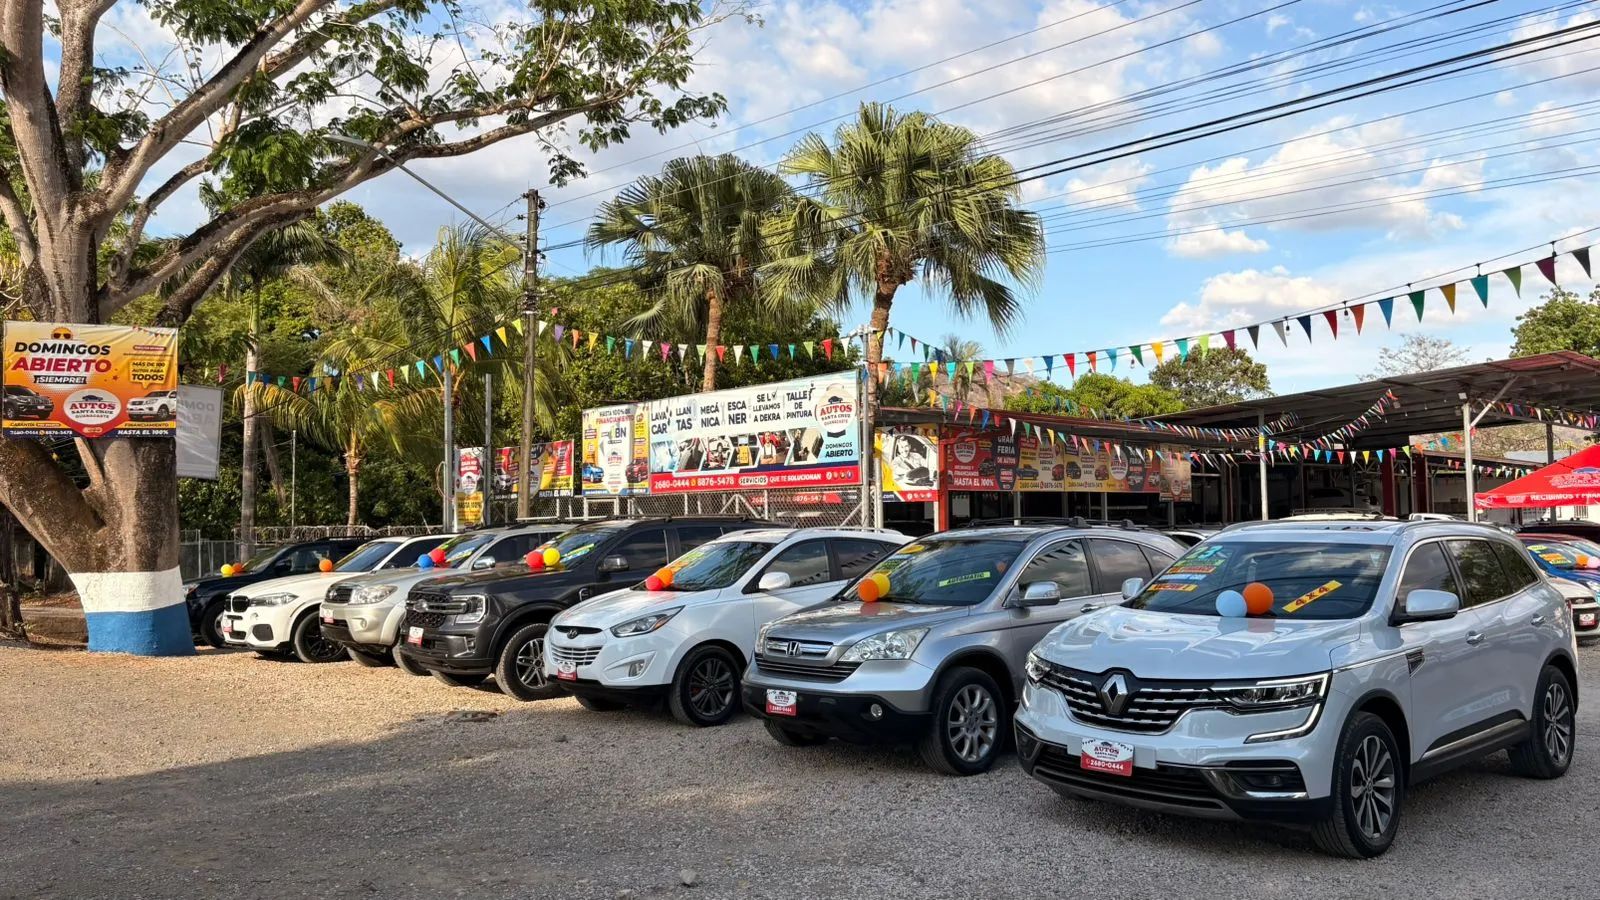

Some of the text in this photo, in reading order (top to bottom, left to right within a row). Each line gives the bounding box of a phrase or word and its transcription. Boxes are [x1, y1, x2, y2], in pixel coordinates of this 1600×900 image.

[14, 342, 111, 356] DOMINGOS
[11, 357, 112, 372] ABIERTO
[36, 376, 85, 384] ¡SIEMPRE!
[757, 394, 765, 402] SE
[700, 402, 719, 414] MECÁ
[728, 400, 746, 411] ESCA
[753, 403, 781, 412] LLEVAMOS
[820, 404, 852, 416] AUTOS
[676, 406, 692, 416] LLAN
[786, 410, 812, 419] PINTURA
[651, 412, 666, 421] LAVA
[728, 413, 747, 425] NER
[760, 412, 781, 422] DEKRA
[676, 418, 692, 431] TAS
[701, 417, 720, 428] NICA
[615, 427, 627, 438] BN
[651, 424, 668, 434] CAR
[825, 449, 853, 458] ABIERTO
[997, 446, 1015, 455] FERIA
[655, 477, 734, 488] 2680-0444 8876-5478
[954, 478, 972, 486] HASTA
[1094, 746, 1120, 754] AUTOS
[1090, 759, 1124, 770] 2680-0444
